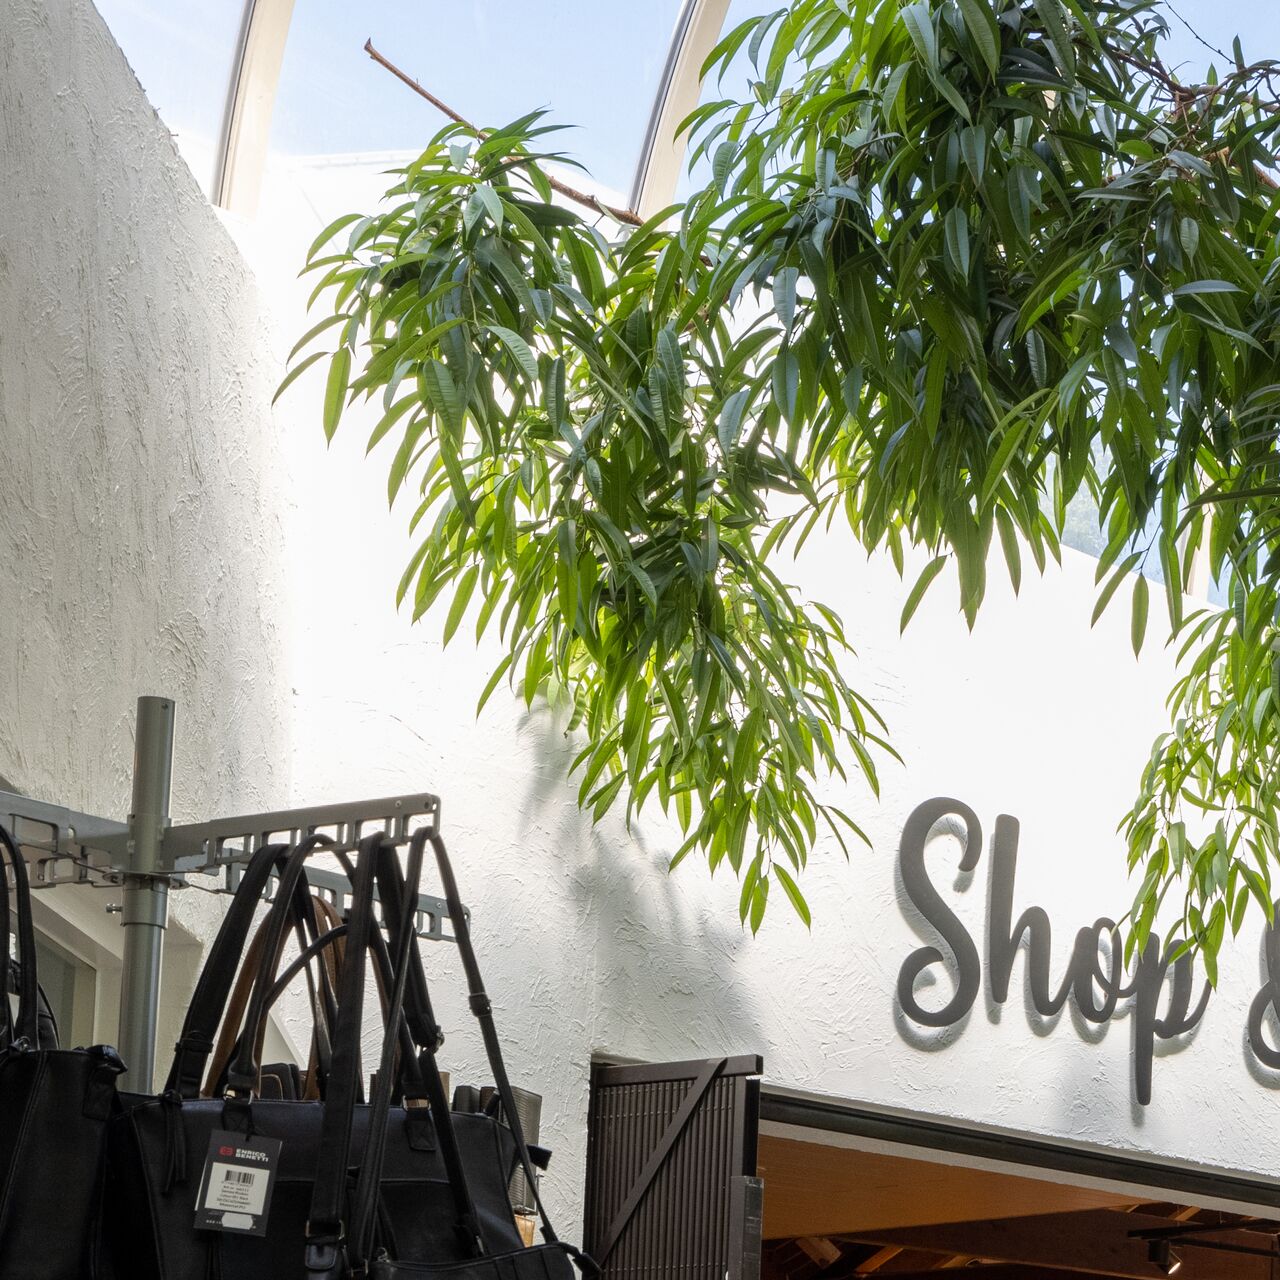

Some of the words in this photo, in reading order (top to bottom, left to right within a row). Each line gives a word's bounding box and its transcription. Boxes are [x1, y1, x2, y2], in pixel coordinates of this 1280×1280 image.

[897, 797, 1212, 1106] Shop
[236, 1148, 266, 1157] ENRICO
[235, 1153, 269, 1162] BENETTI
